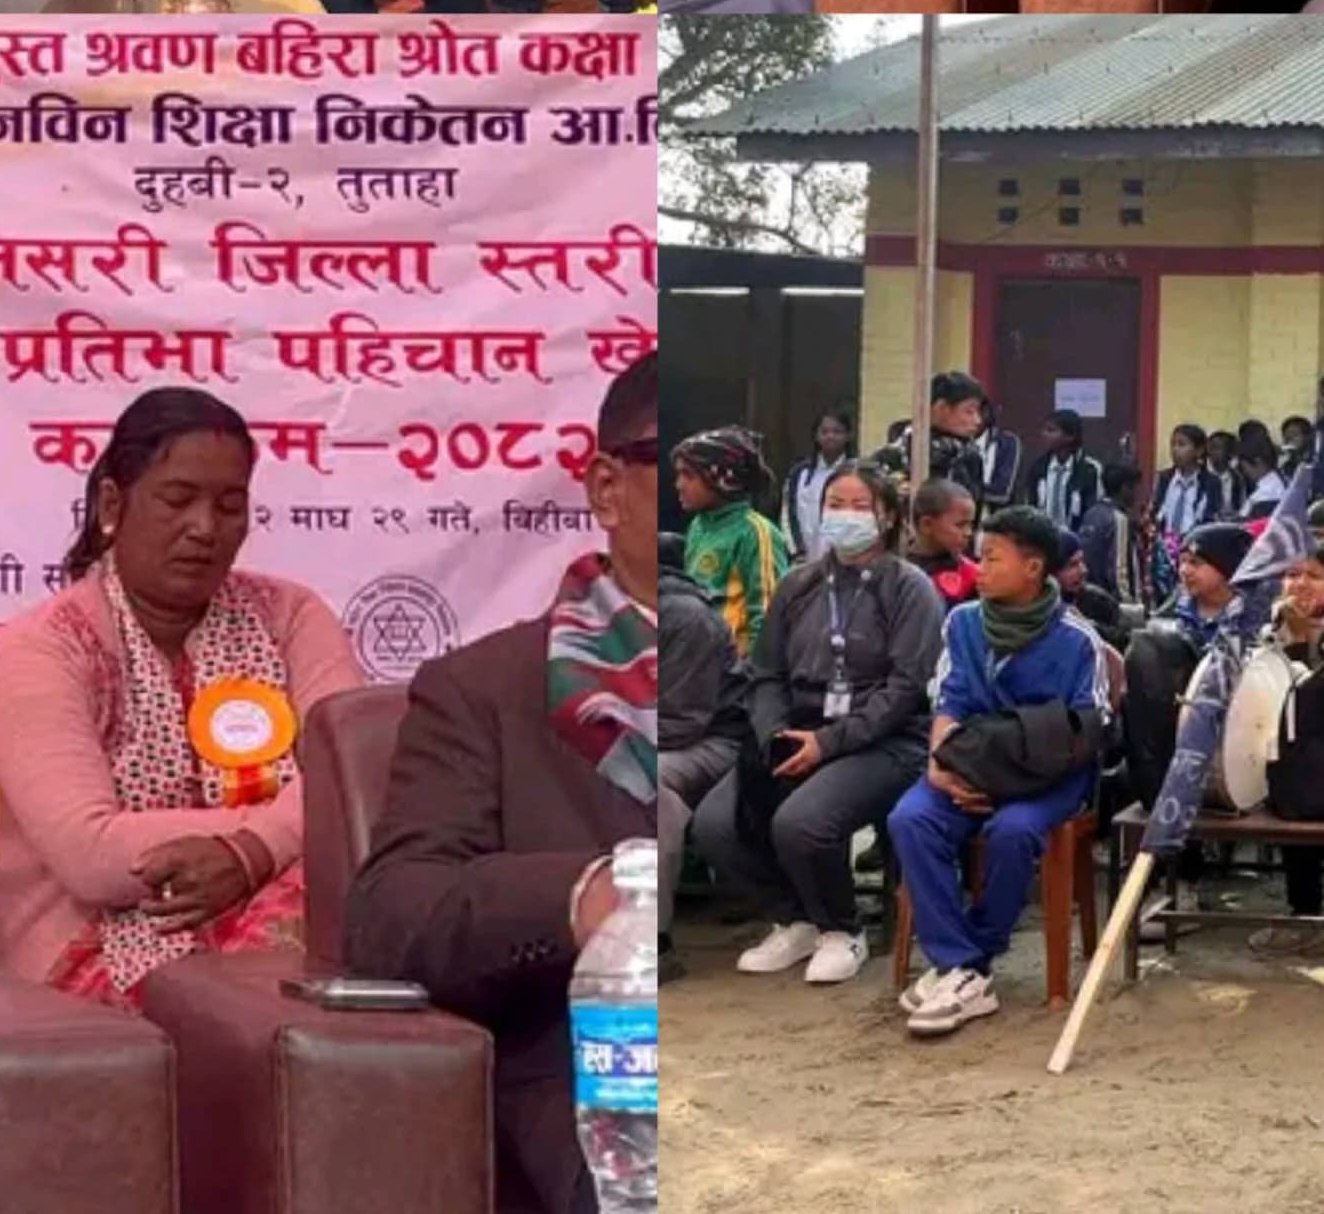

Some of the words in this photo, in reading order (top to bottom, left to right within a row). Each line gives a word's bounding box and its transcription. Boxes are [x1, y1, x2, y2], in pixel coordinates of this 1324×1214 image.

[85, 31, 218, 77] श्रवण
[235, 18, 380, 80] बहिरा
[396, 18, 502, 79] श्रोत
[519, 31, 642, 81] कक्षा
[151, 91, 297, 148] शिक्षा
[314, 92, 530, 146] निकेतन
[336, 166, 460, 214] तुताहा
[208, 220, 443, 293] जिल्ला
[271, 310, 554, 388] पहिचान
[289, 503, 354, 534] माघ
[426, 498, 480, 537] गते,
